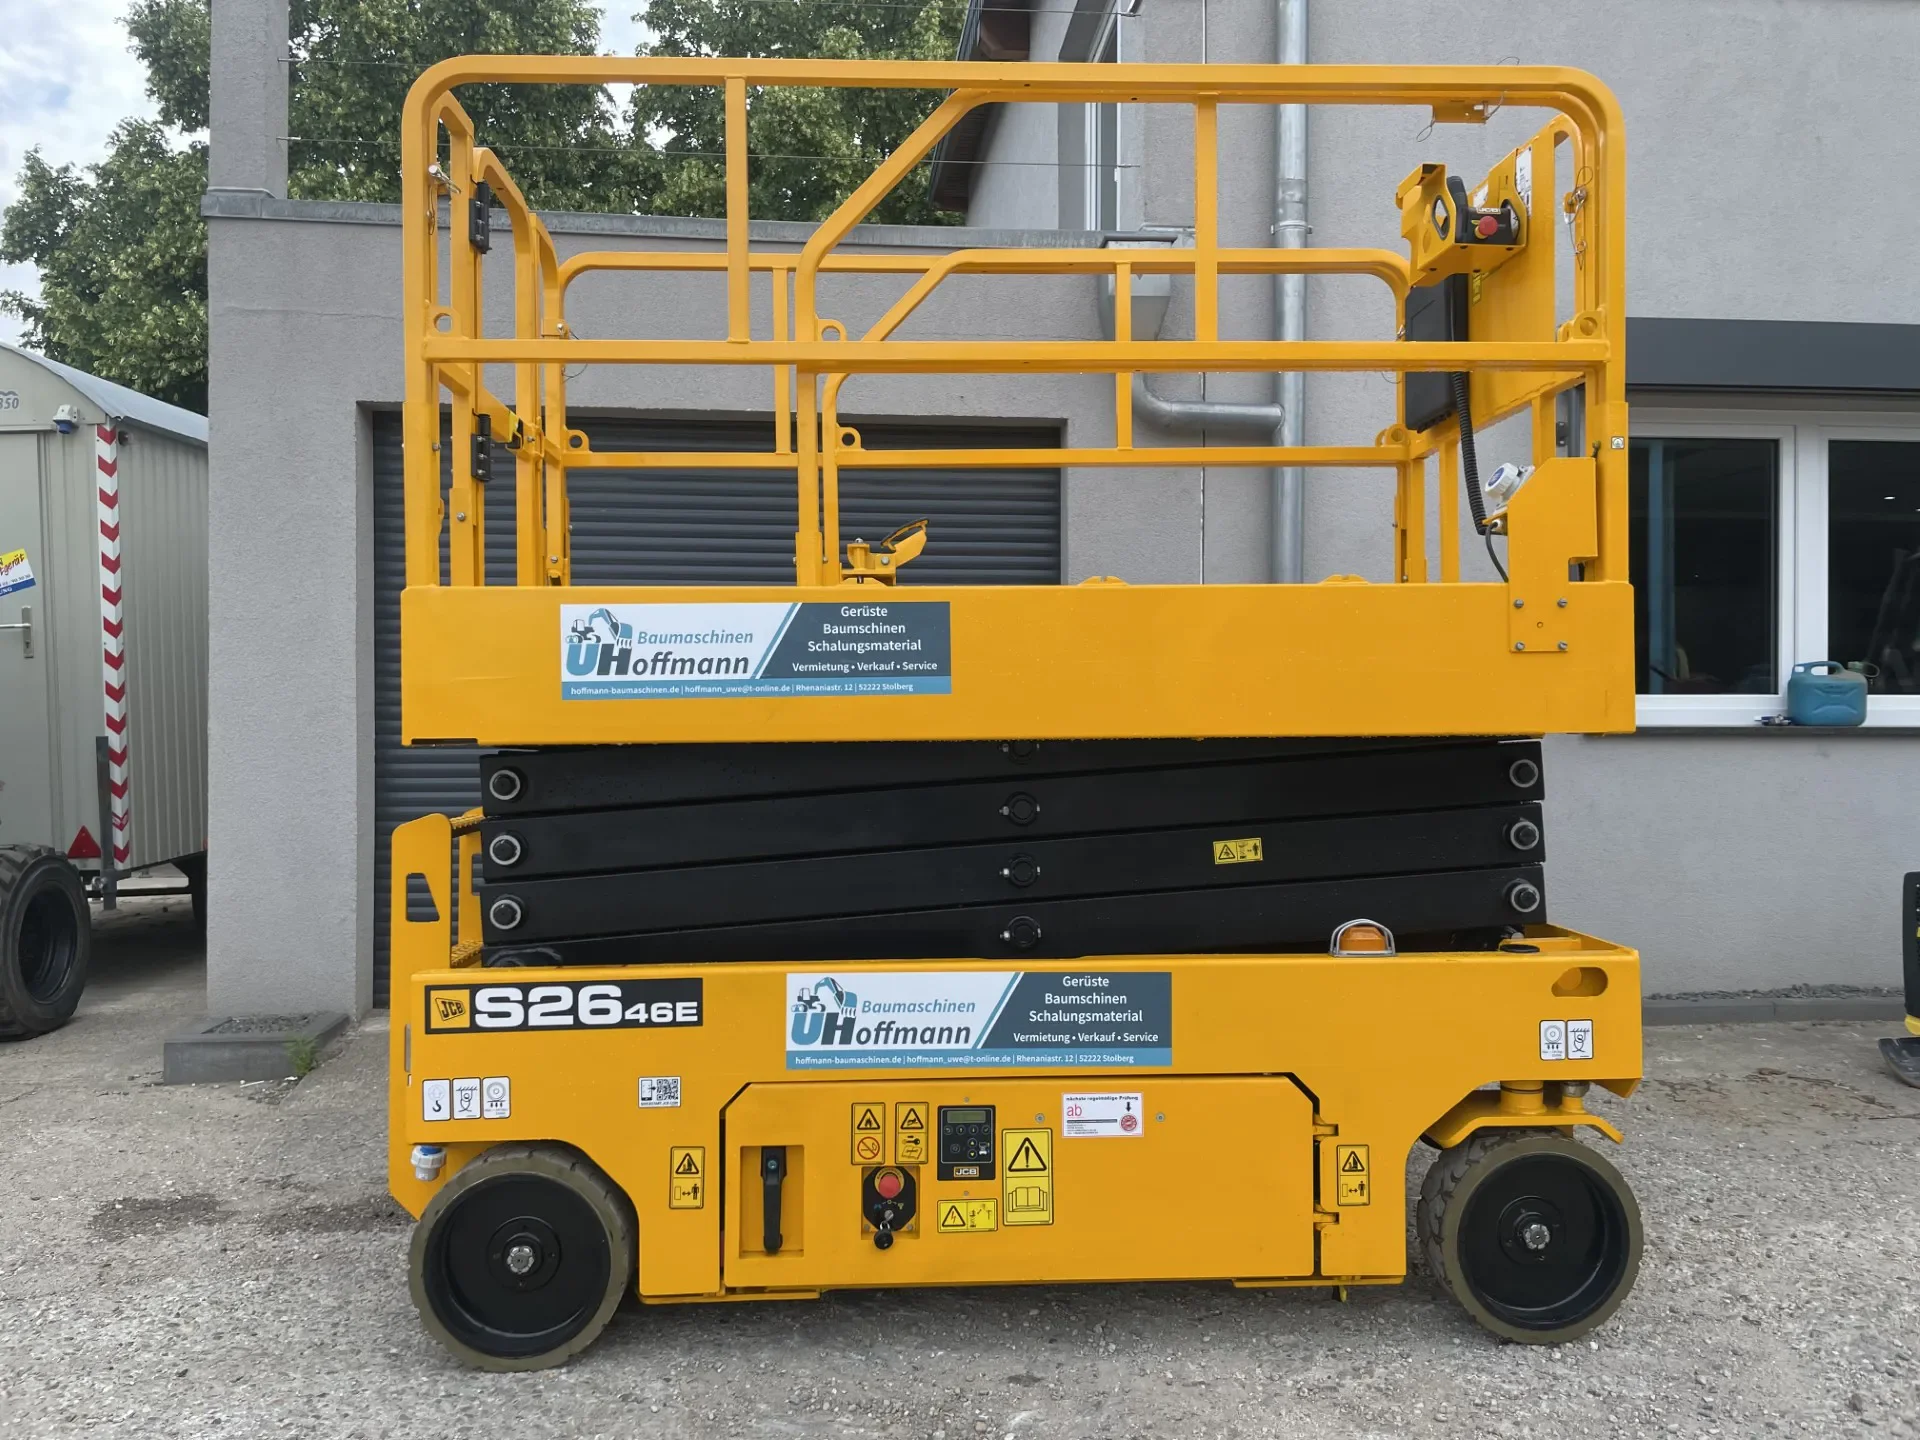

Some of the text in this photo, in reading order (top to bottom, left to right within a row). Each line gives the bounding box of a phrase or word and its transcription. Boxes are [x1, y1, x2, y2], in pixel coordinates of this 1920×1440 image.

[840, 606, 888, 617] Gerüste
[823, 622, 906, 635] Baumschinen
[637, 629, 754, 645] Baumaschinen
[807, 639, 922, 654] Schalungsmaterial
[792, 661, 938, 673] Vermietung Verkauf Service
[570, 685, 680, 695] hoffmann-baumaschinen.de
[685, 682, 790, 693] hoffmann_uwe@t-online.de
[844, 683, 853, 691] 12
[858, 682, 881, 691] 52222
[882, 681, 914, 692] Stolberg
[1062, 975, 1110, 987] Gerüste
[1045, 992, 1128, 1005] Baumschinen
[442, 1001, 464, 1019] JCB
[861, 999, 976, 1014] Baumaschinen
[1028, 1009, 1143, 1025] Schalungsmaterial
[1013, 1032, 1159, 1044] Vermietung Verkauf Service
[795, 1056, 902, 1065] hoffmann-baumaschinen.de
[906, 1054, 1011, 1064] hoffmann_uwe@t-online.de
[1065, 1054, 1074, 1063] 12
[1079, 1054, 1101, 1063] 52222
[1103, 1054, 1134, 1064] Stolberg
[1066, 1103, 1082, 1117] ab
